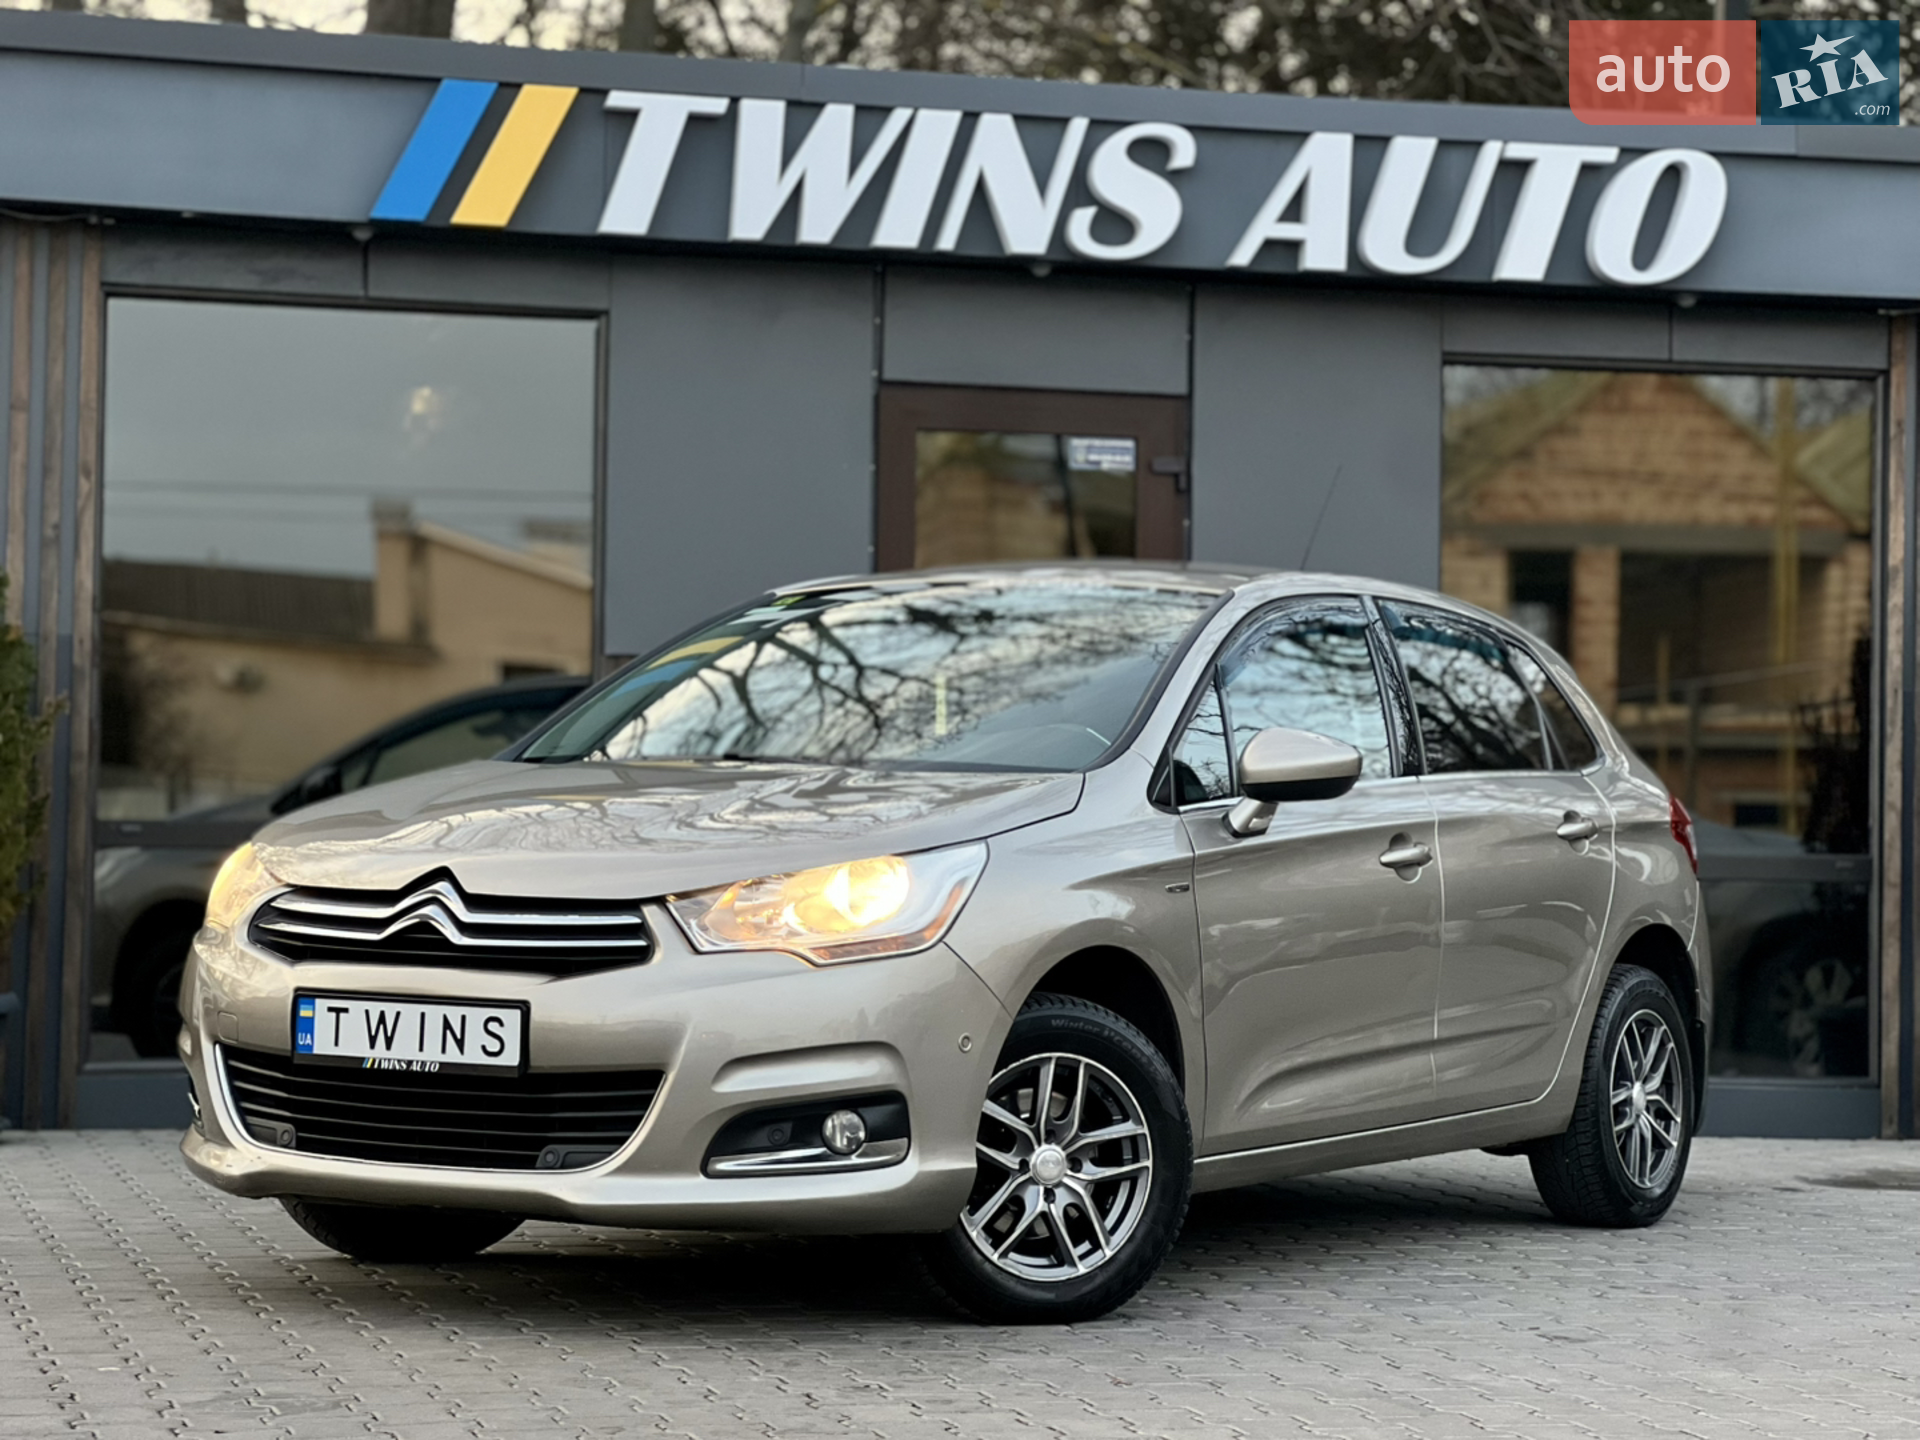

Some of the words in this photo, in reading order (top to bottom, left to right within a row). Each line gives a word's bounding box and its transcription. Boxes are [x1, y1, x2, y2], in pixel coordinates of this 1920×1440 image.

[597, 90, 1197, 260] TWINS
[1226, 132, 1727, 285] AUTO
[298, 1032, 312, 1046] UA
[326, 1006, 505, 1058] TWINS
[374, 1058, 407, 1071] TWINS
[409, 1060, 440, 1073] AUTO
